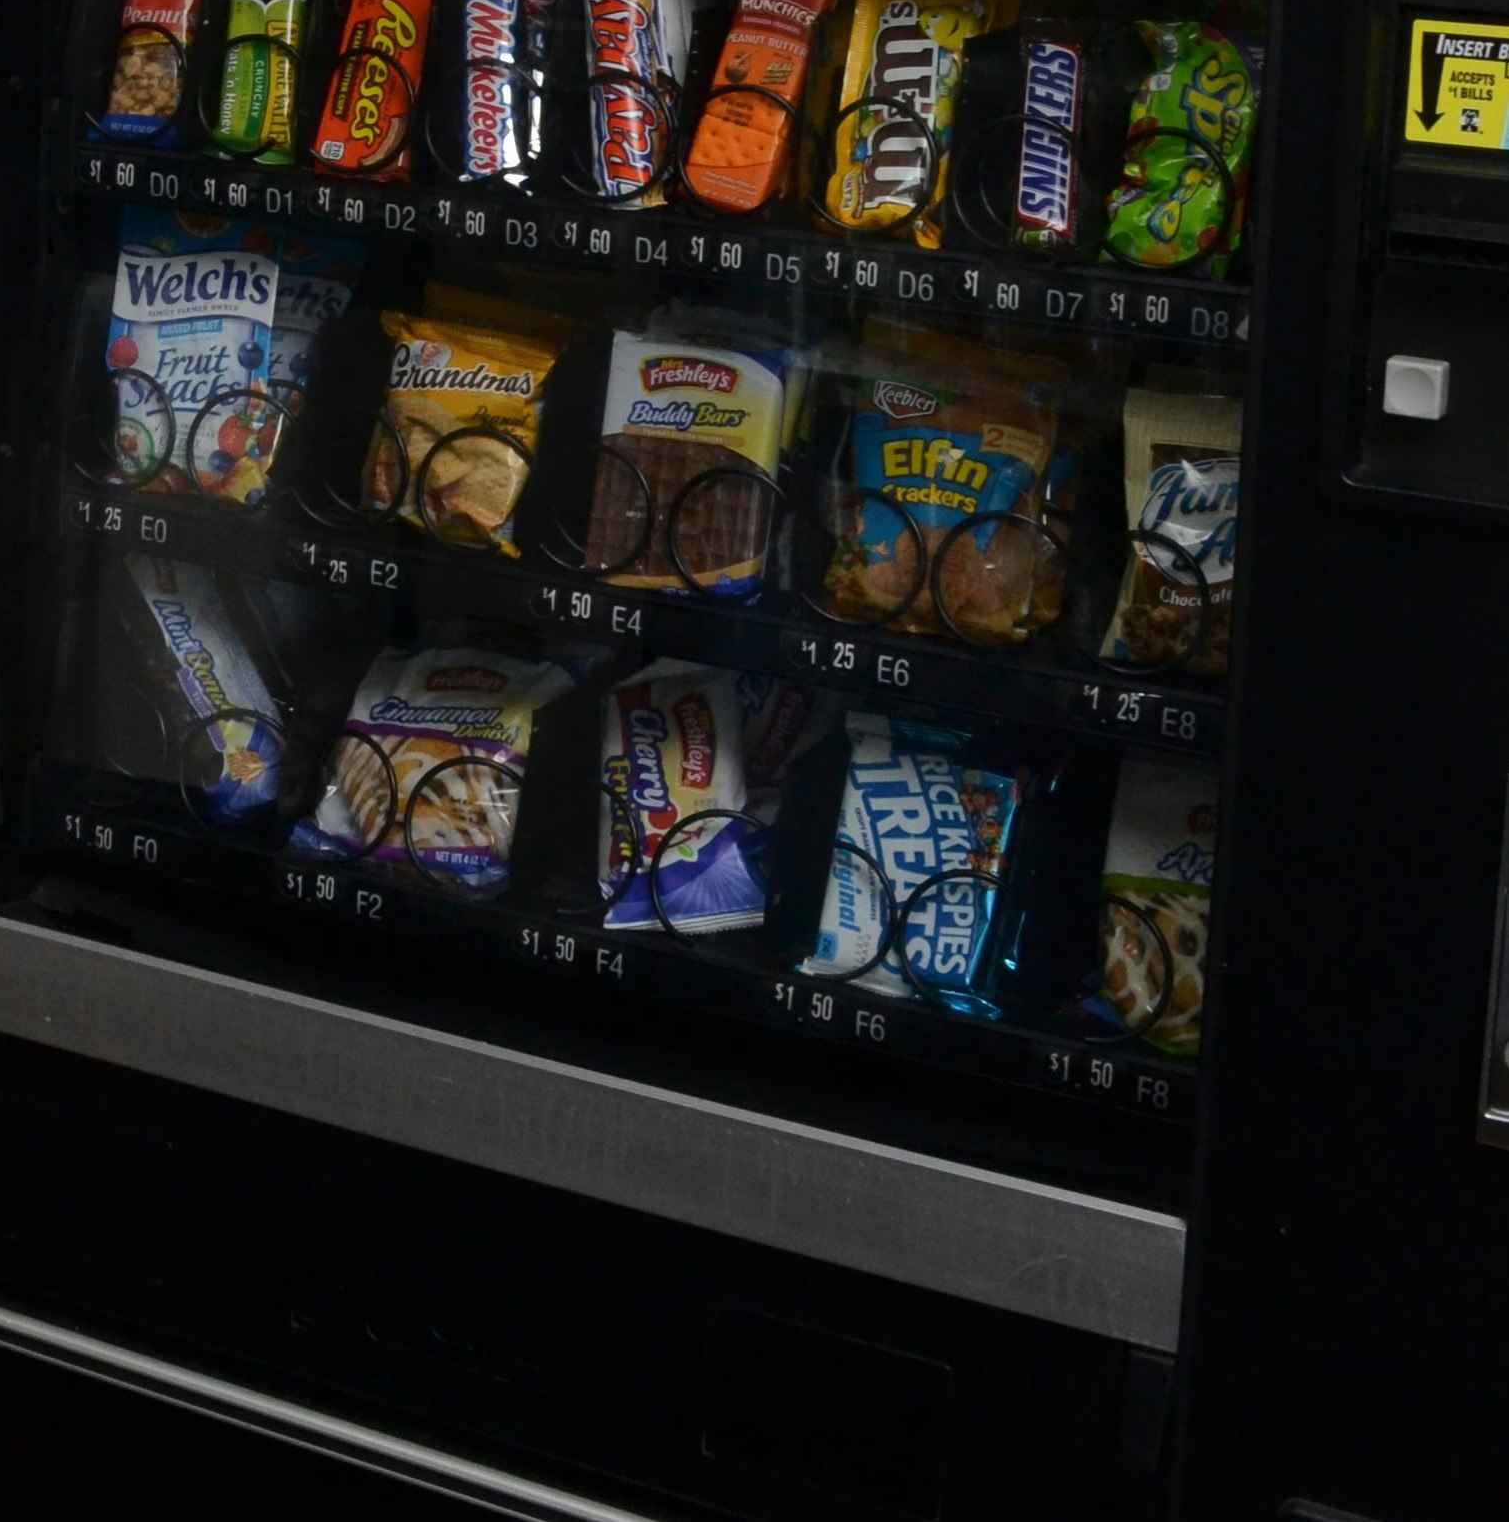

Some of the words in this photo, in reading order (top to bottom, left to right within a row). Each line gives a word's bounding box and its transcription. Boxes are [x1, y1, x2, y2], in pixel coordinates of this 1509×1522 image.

[766, 37, 809, 58] BUTTER
[1436, 33, 1492, 60] INSERT
[250, 59, 265, 119] CRUNCHY
[466, 0, 517, 176] Musketeers
[1449, 70, 1496, 87] ACCEPTS
[1460, 87, 1493, 102] BILLS
[218, 92, 238, 135] Honey
[1019, 43, 1077, 227] SNICKERS
[150, 172, 179, 200] D0
[266, 187, 293, 215] D1
[384, 203, 416, 233] D2
[505, 218, 538, 249] D3
[635, 236, 669, 266] D4
[124, 258, 271, 307] Welch's
[766, 253, 802, 284] D5
[898, 269, 935, 302] D6
[1046, 289, 1084, 321] D7
[1191, 307, 1229, 340] D8
[154, 345, 231, 378] Fruit
[389, 342, 535, 397] Grandma's
[650, 363, 732, 391] Freshley's
[123, 374, 242, 409] Snacks
[874, 382, 935, 411] Keebler
[629, 400, 694, 430] Buddy
[693, 401, 744, 428] Bars
[882, 437, 990, 491] Elfin
[141, 515, 167, 543] E0
[369, 558, 399, 590] E2
[611, 604, 642, 637] E4
[876, 654, 911, 687] E6
[369, 696, 503, 724] Cinnamon
[1160, 706, 1197, 741] E8
[451, 722, 519, 745] Danish
[678, 701, 708, 784] Freshley's
[629, 708, 666, 809] Cherry
[916, 755, 968, 822] RICE
[132, 834, 158, 864] F0
[434, 850, 450, 863] NET
[853, 754, 938, 972] TREATS
[831, 832, 863, 934] Original
[355, 890, 383, 921] F2
[933, 826, 976, 976] KRISPIES
[595, 947, 625, 980] F4
[854, 1009, 886, 1042] F6
[1136, 1074, 1170, 1110] F8
